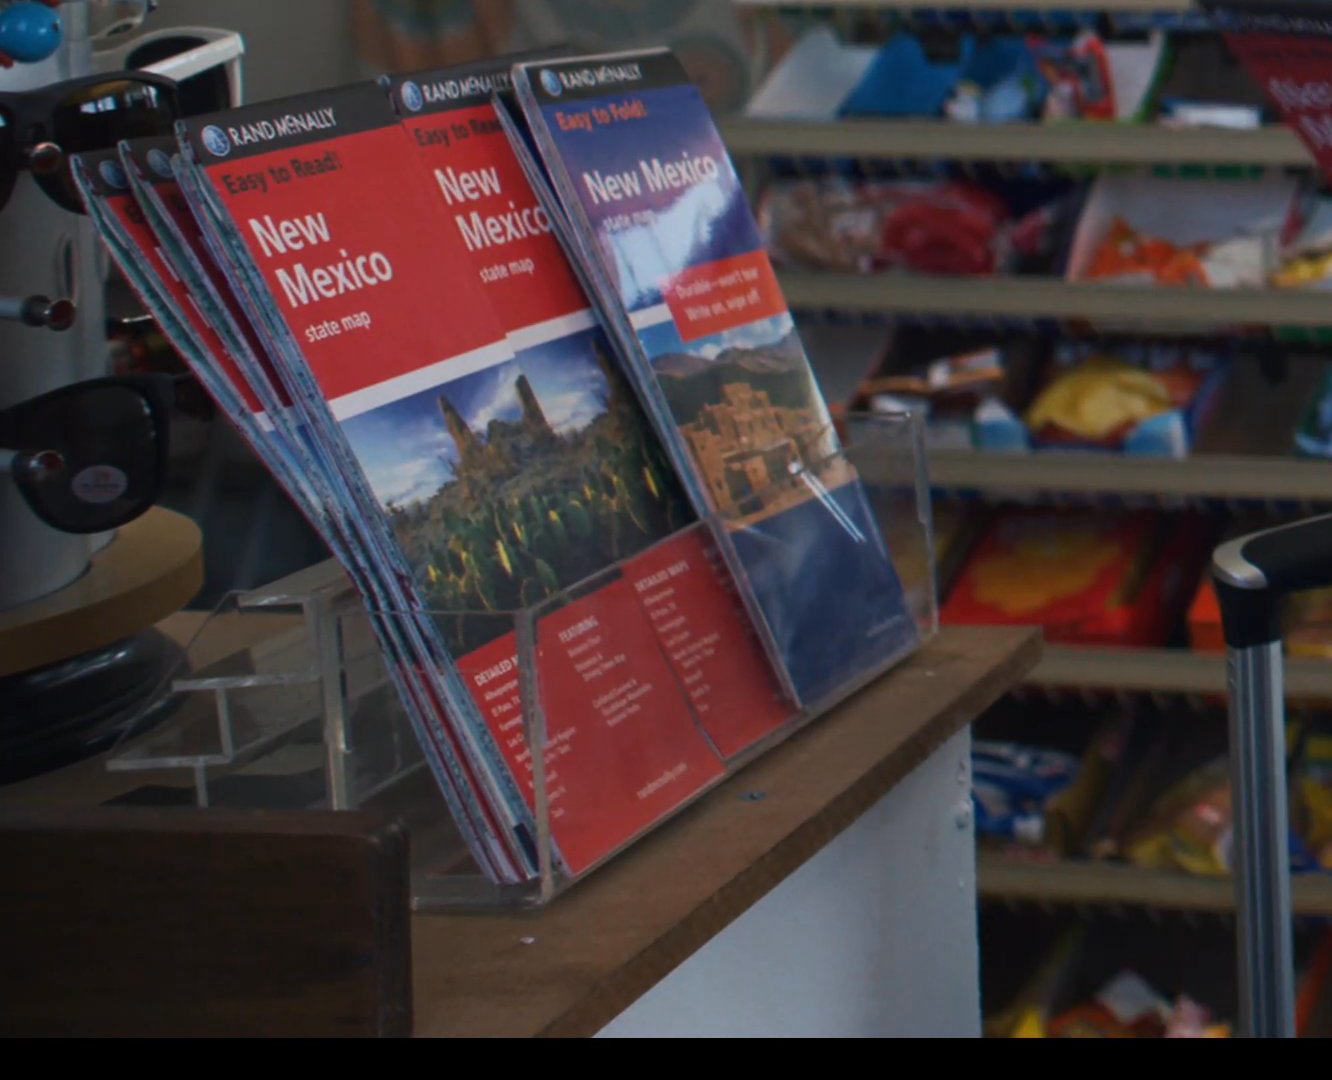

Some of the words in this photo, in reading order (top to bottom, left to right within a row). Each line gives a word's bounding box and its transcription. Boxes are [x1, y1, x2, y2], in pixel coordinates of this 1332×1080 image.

[422, 80, 459, 103] RAND
[561, 70, 596, 89] RAND
[556, 111, 592, 131] Easy
[592, 107, 609, 125] to
[610, 99, 647, 120] Fold!
[228, 121, 277, 147] RAND
[414, 127, 450, 148] Easy
[450, 123, 468, 141] to
[222, 171, 268, 196] Easy
[269, 165, 291, 185] to
[290, 151, 343, 177] Read!
[434, 166, 502, 205] New
[583, 171, 640, 204] New
[639, 151, 720, 192] Mexico
[249, 212, 331, 258] New
[455, 201, 552, 252] Mexico
[275, 248, 393, 308] Mexico
[480, 262, 508, 283] state
[508, 258, 535, 276] map
[304, 319, 341, 343] state
[341, 310, 371, 331] map
[474, 658, 512, 687] DETAILED
